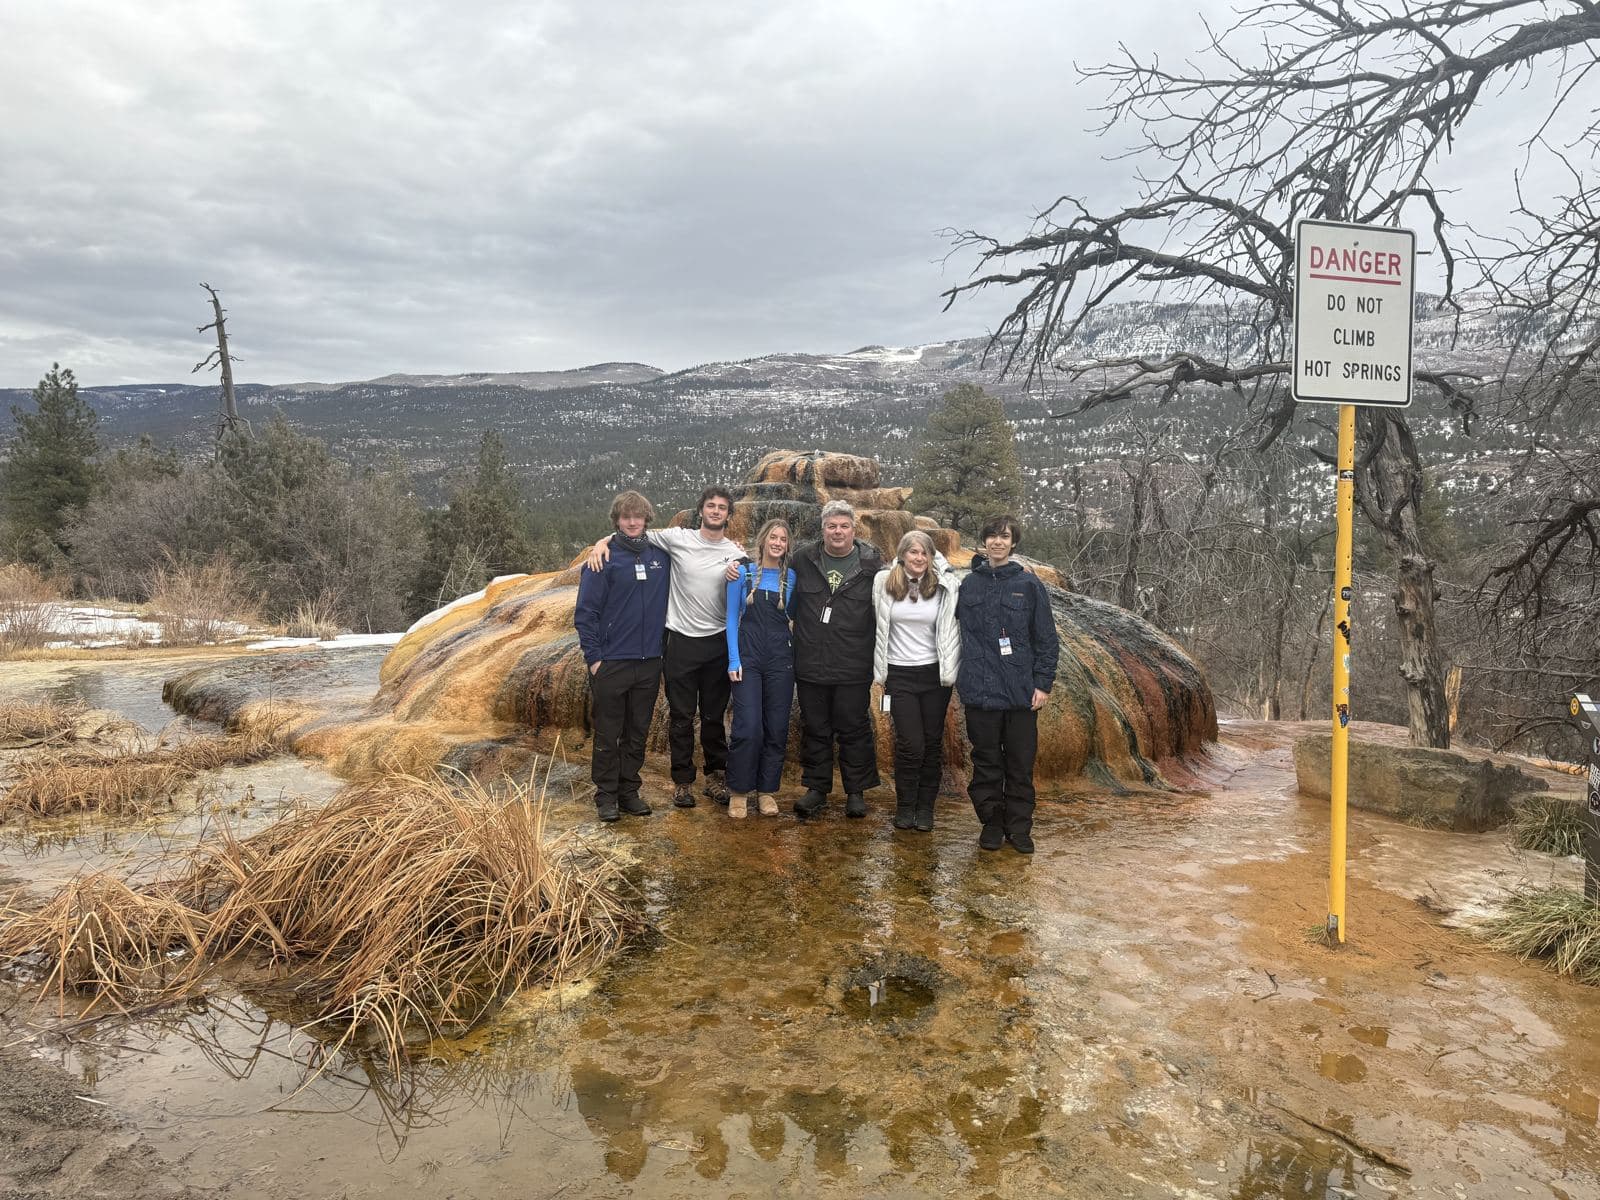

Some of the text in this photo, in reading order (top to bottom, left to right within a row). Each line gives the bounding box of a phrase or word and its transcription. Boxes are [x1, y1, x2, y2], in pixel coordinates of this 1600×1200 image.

[1310, 246, 1401, 276] DANGER
[1327, 294, 1383, 314] DO NOT
[1333, 328, 1375, 347] CLIMB
[1304, 360, 1401, 382] HOT SPRINGS
